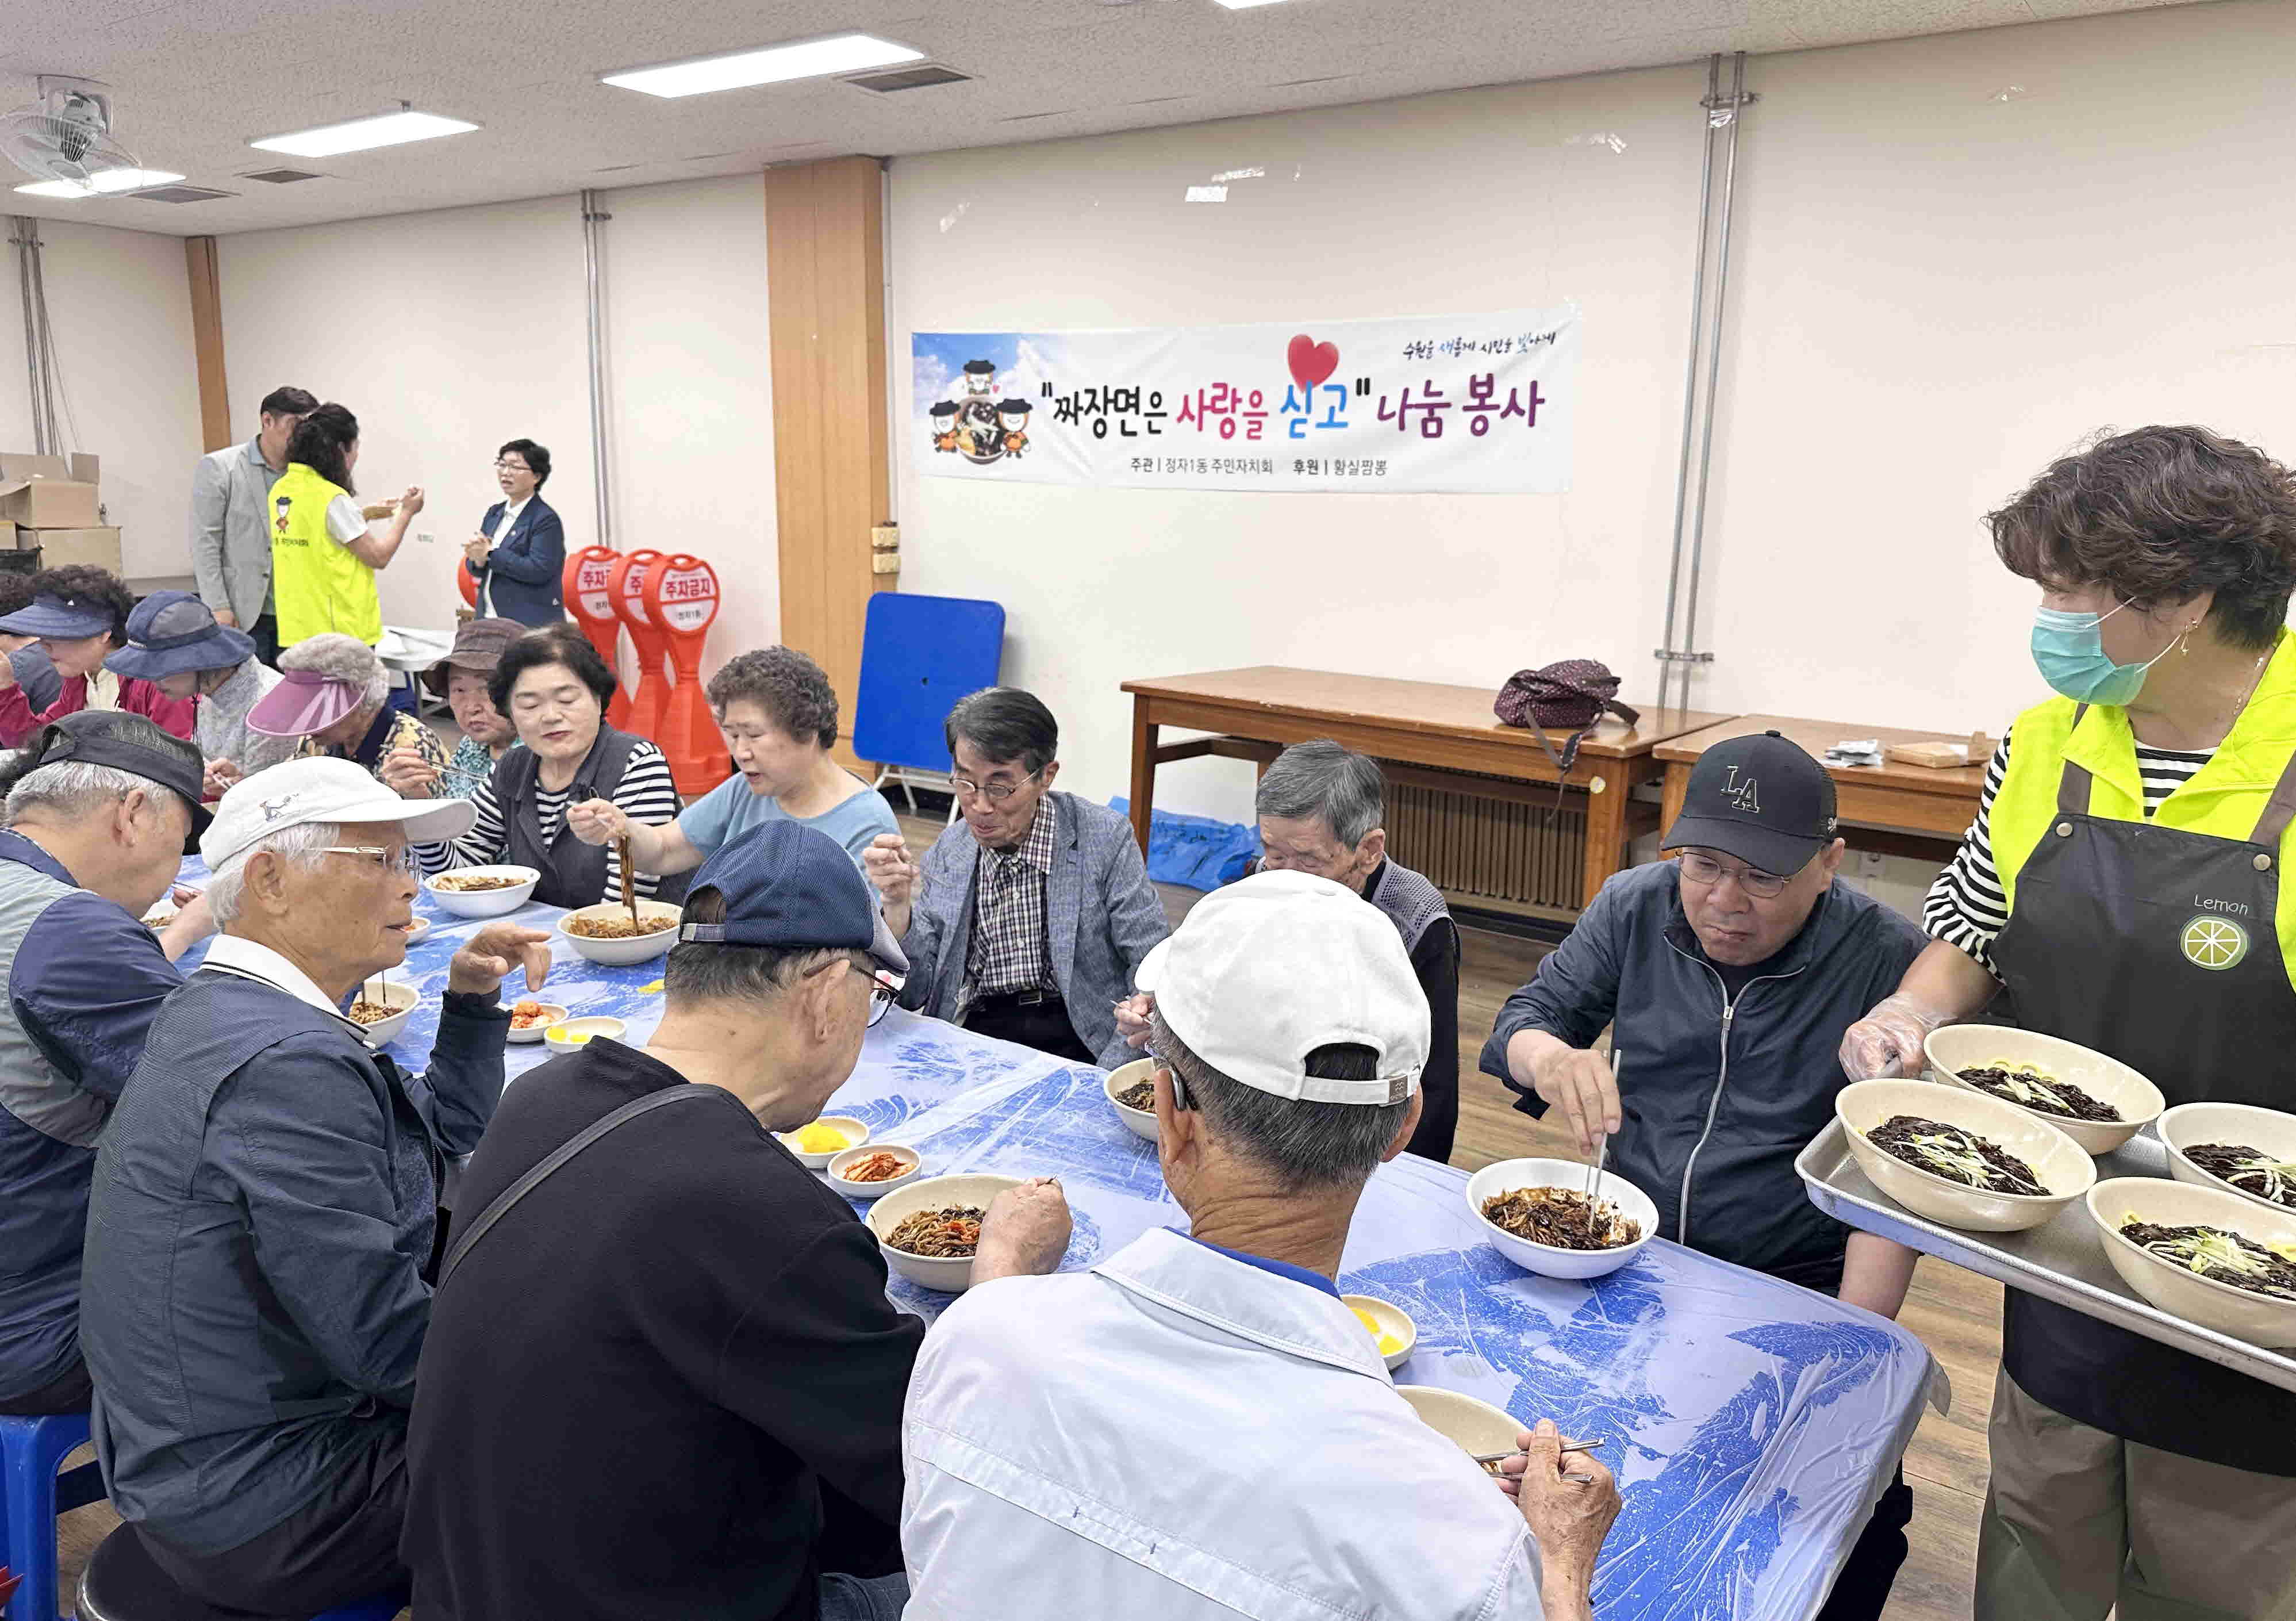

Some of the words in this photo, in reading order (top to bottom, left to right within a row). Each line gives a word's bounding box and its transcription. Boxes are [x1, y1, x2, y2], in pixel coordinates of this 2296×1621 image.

[1041, 382, 1168, 439] "짜장면은
[1177, 382, 1269, 440] 사랑을
[1280, 377, 1370, 439] 싣고"
[1377, 380, 1452, 439] 나눔
[1462, 373, 1545, 437] 봉사
[1131, 458, 1153, 472] 주관
[1165, 458, 1208, 474] 정자1동
[1211, 459, 1273, 474] 주민자치회
[1293, 459, 1318, 476] 후원
[666, 578, 710, 599] 주차금지
[1719, 765, 1760, 814] LA
[2194, 894, 2248, 916] Lemon
